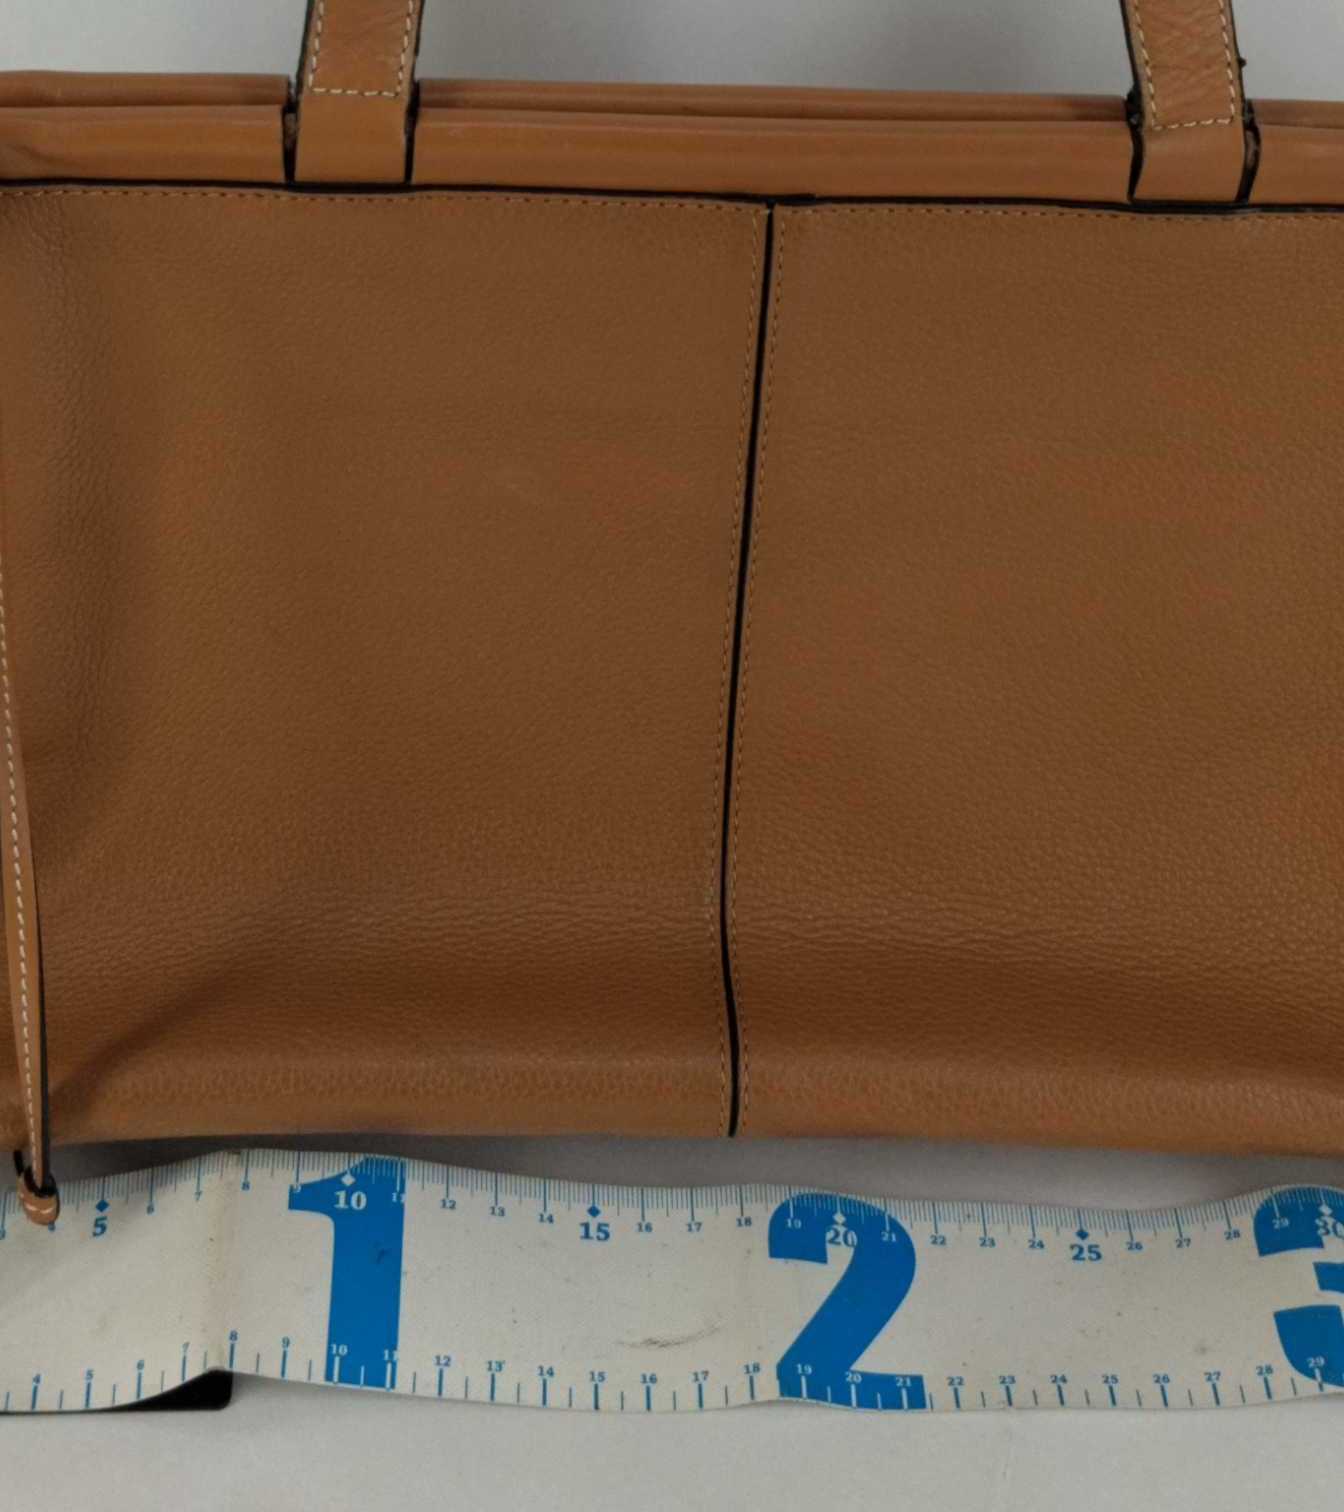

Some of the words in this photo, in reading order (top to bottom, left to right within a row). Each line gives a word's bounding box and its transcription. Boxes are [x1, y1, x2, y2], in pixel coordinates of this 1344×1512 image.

[92, 1217, 107, 1238] 5
[194, 1192, 202, 1201] 7
[335, 1191, 366, 1210] 10
[441, 1200, 456, 1209] 12
[490, 1207, 506, 1216] 13
[538, 1213, 554, 1223] 14
[579, 1222, 611, 1241] 15
[637, 1223, 652, 1231] 16
[687, 1223, 702, 1231] 17
[736, 1217, 751, 1227] 18
[786, 1219, 801, 1229] 19
[826, 1229, 857, 1247] 20
[882, 1232, 897, 1241] 21
[930, 1236, 946, 1246] 22
[979, 1238, 995, 1247] 23
[1029, 1239, 1045, 1249] 24
[1070, 1244, 1102, 1261] 25
[1127, 1241, 1143, 1250] 26
[1176, 1238, 1191, 1247] 27
[1225, 1231, 1241, 1240] 28
[289, 1157, 406, 1388] 1
[768, 1193, 926, 1410] 2
[33, 1374, 41, 1385] 4
[86, 1371, 94, 1380] 5
[136, 1361, 144, 1371] 6
[182, 1343, 190, 1354] 7
[230, 1331, 238, 1342] 8
[282, 1337, 290, 1348] 9
[330, 1344, 348, 1356] 10
[383, 1350, 396, 1361] 11
[434, 1356, 451, 1366] 12
[487, 1361, 502, 1372] 13
[538, 1366, 554, 1377] 14
[589, 1371, 605, 1381] 15
[641, 1373, 657, 1384] 16
[693, 1372, 709, 1382] 17
[744, 1364, 760, 1374] 18
[796, 1365, 812, 1375] 19
[845, 1372, 862, 1382] 20
[896, 1377, 912, 1387] 21
[947, 1375, 964, 1386] 22
[999, 1374, 1016, 1385] 23
[1050, 1374, 1067, 1385] 24
[1102, 1374, 1119, 1385] 25
[1153, 1373, 1170, 1383] 26
[1205, 1373, 1221, 1383] 27
[1257, 1365, 1273, 1375] 28
[1307, 1357, 1324, 1367] 29
